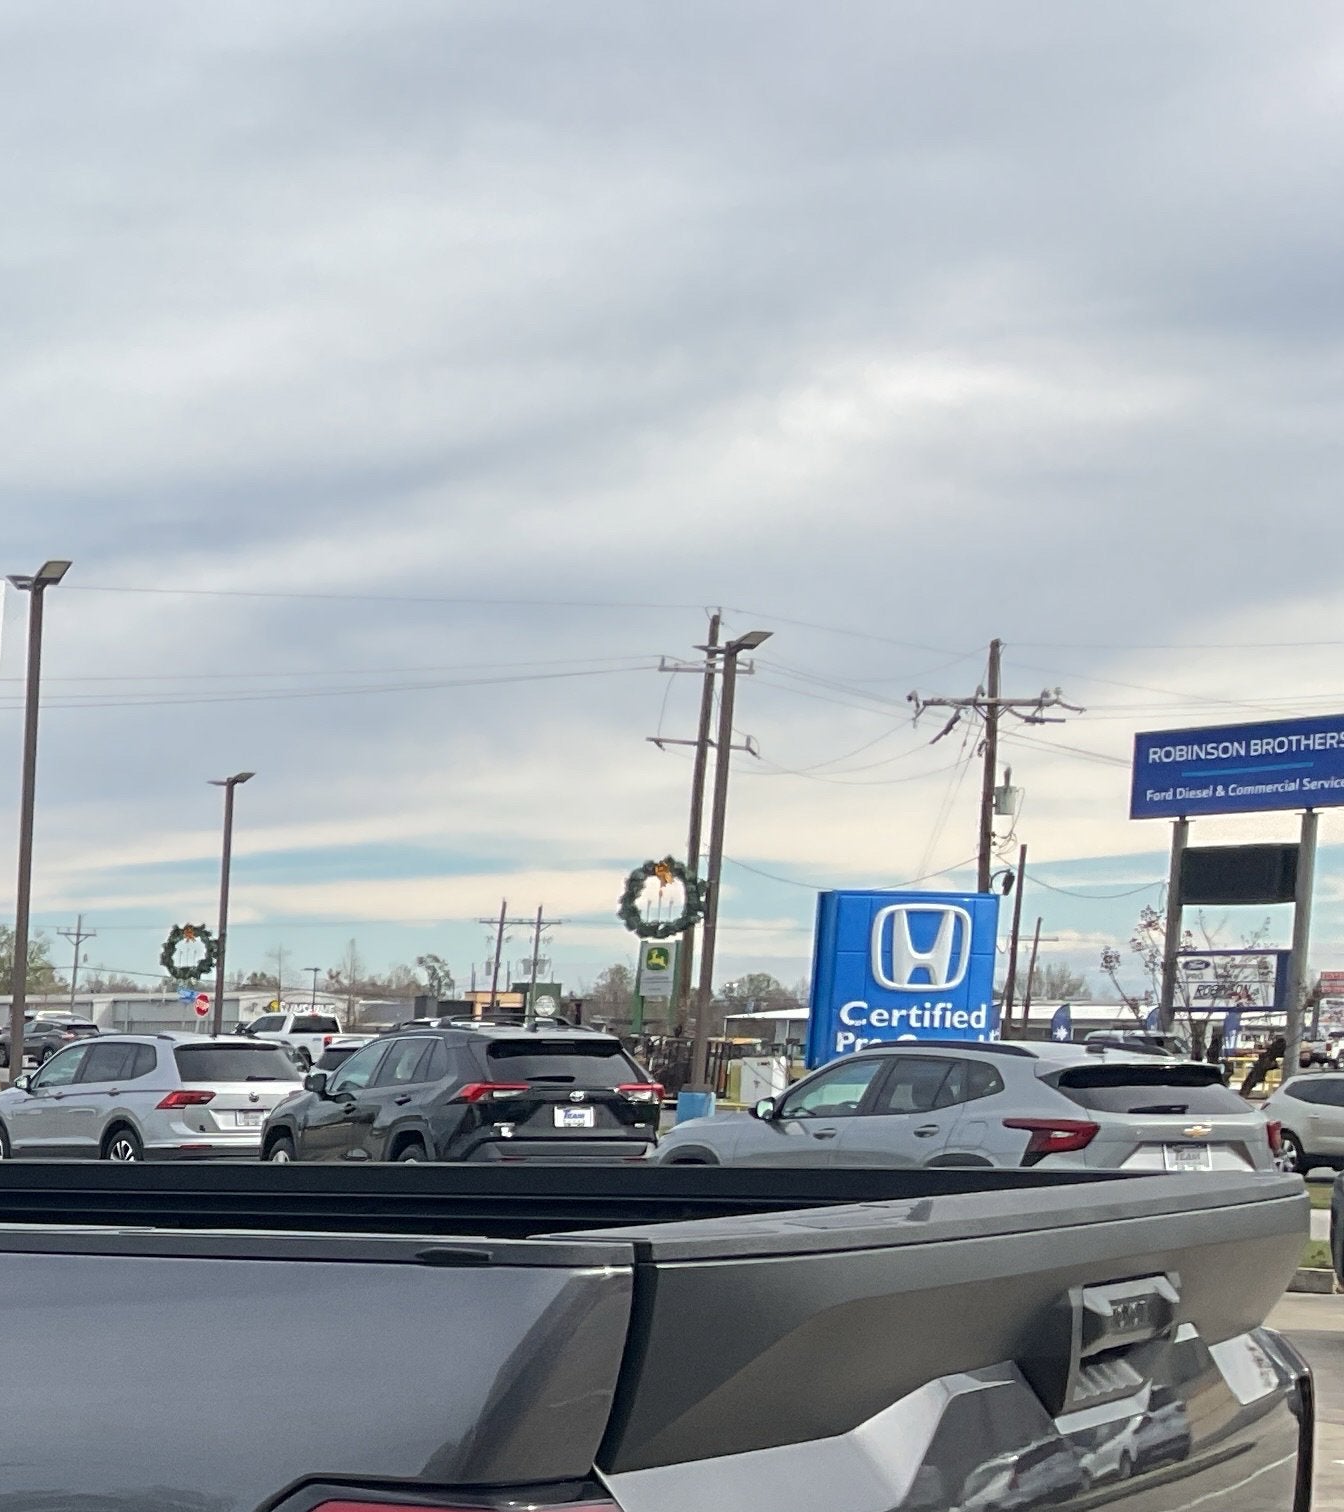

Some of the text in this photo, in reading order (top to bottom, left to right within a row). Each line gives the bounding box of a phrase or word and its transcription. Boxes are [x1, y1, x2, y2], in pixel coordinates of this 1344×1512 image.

[1148, 740, 1246, 764] ROBINSON
[1146, 788, 1173, 802] Ford
[1176, 785, 1213, 800] Diesel
[1215, 784, 1226, 797] &
[1228, 778, 1300, 797] Commercial
[839, 1000, 987, 1029] Certified
